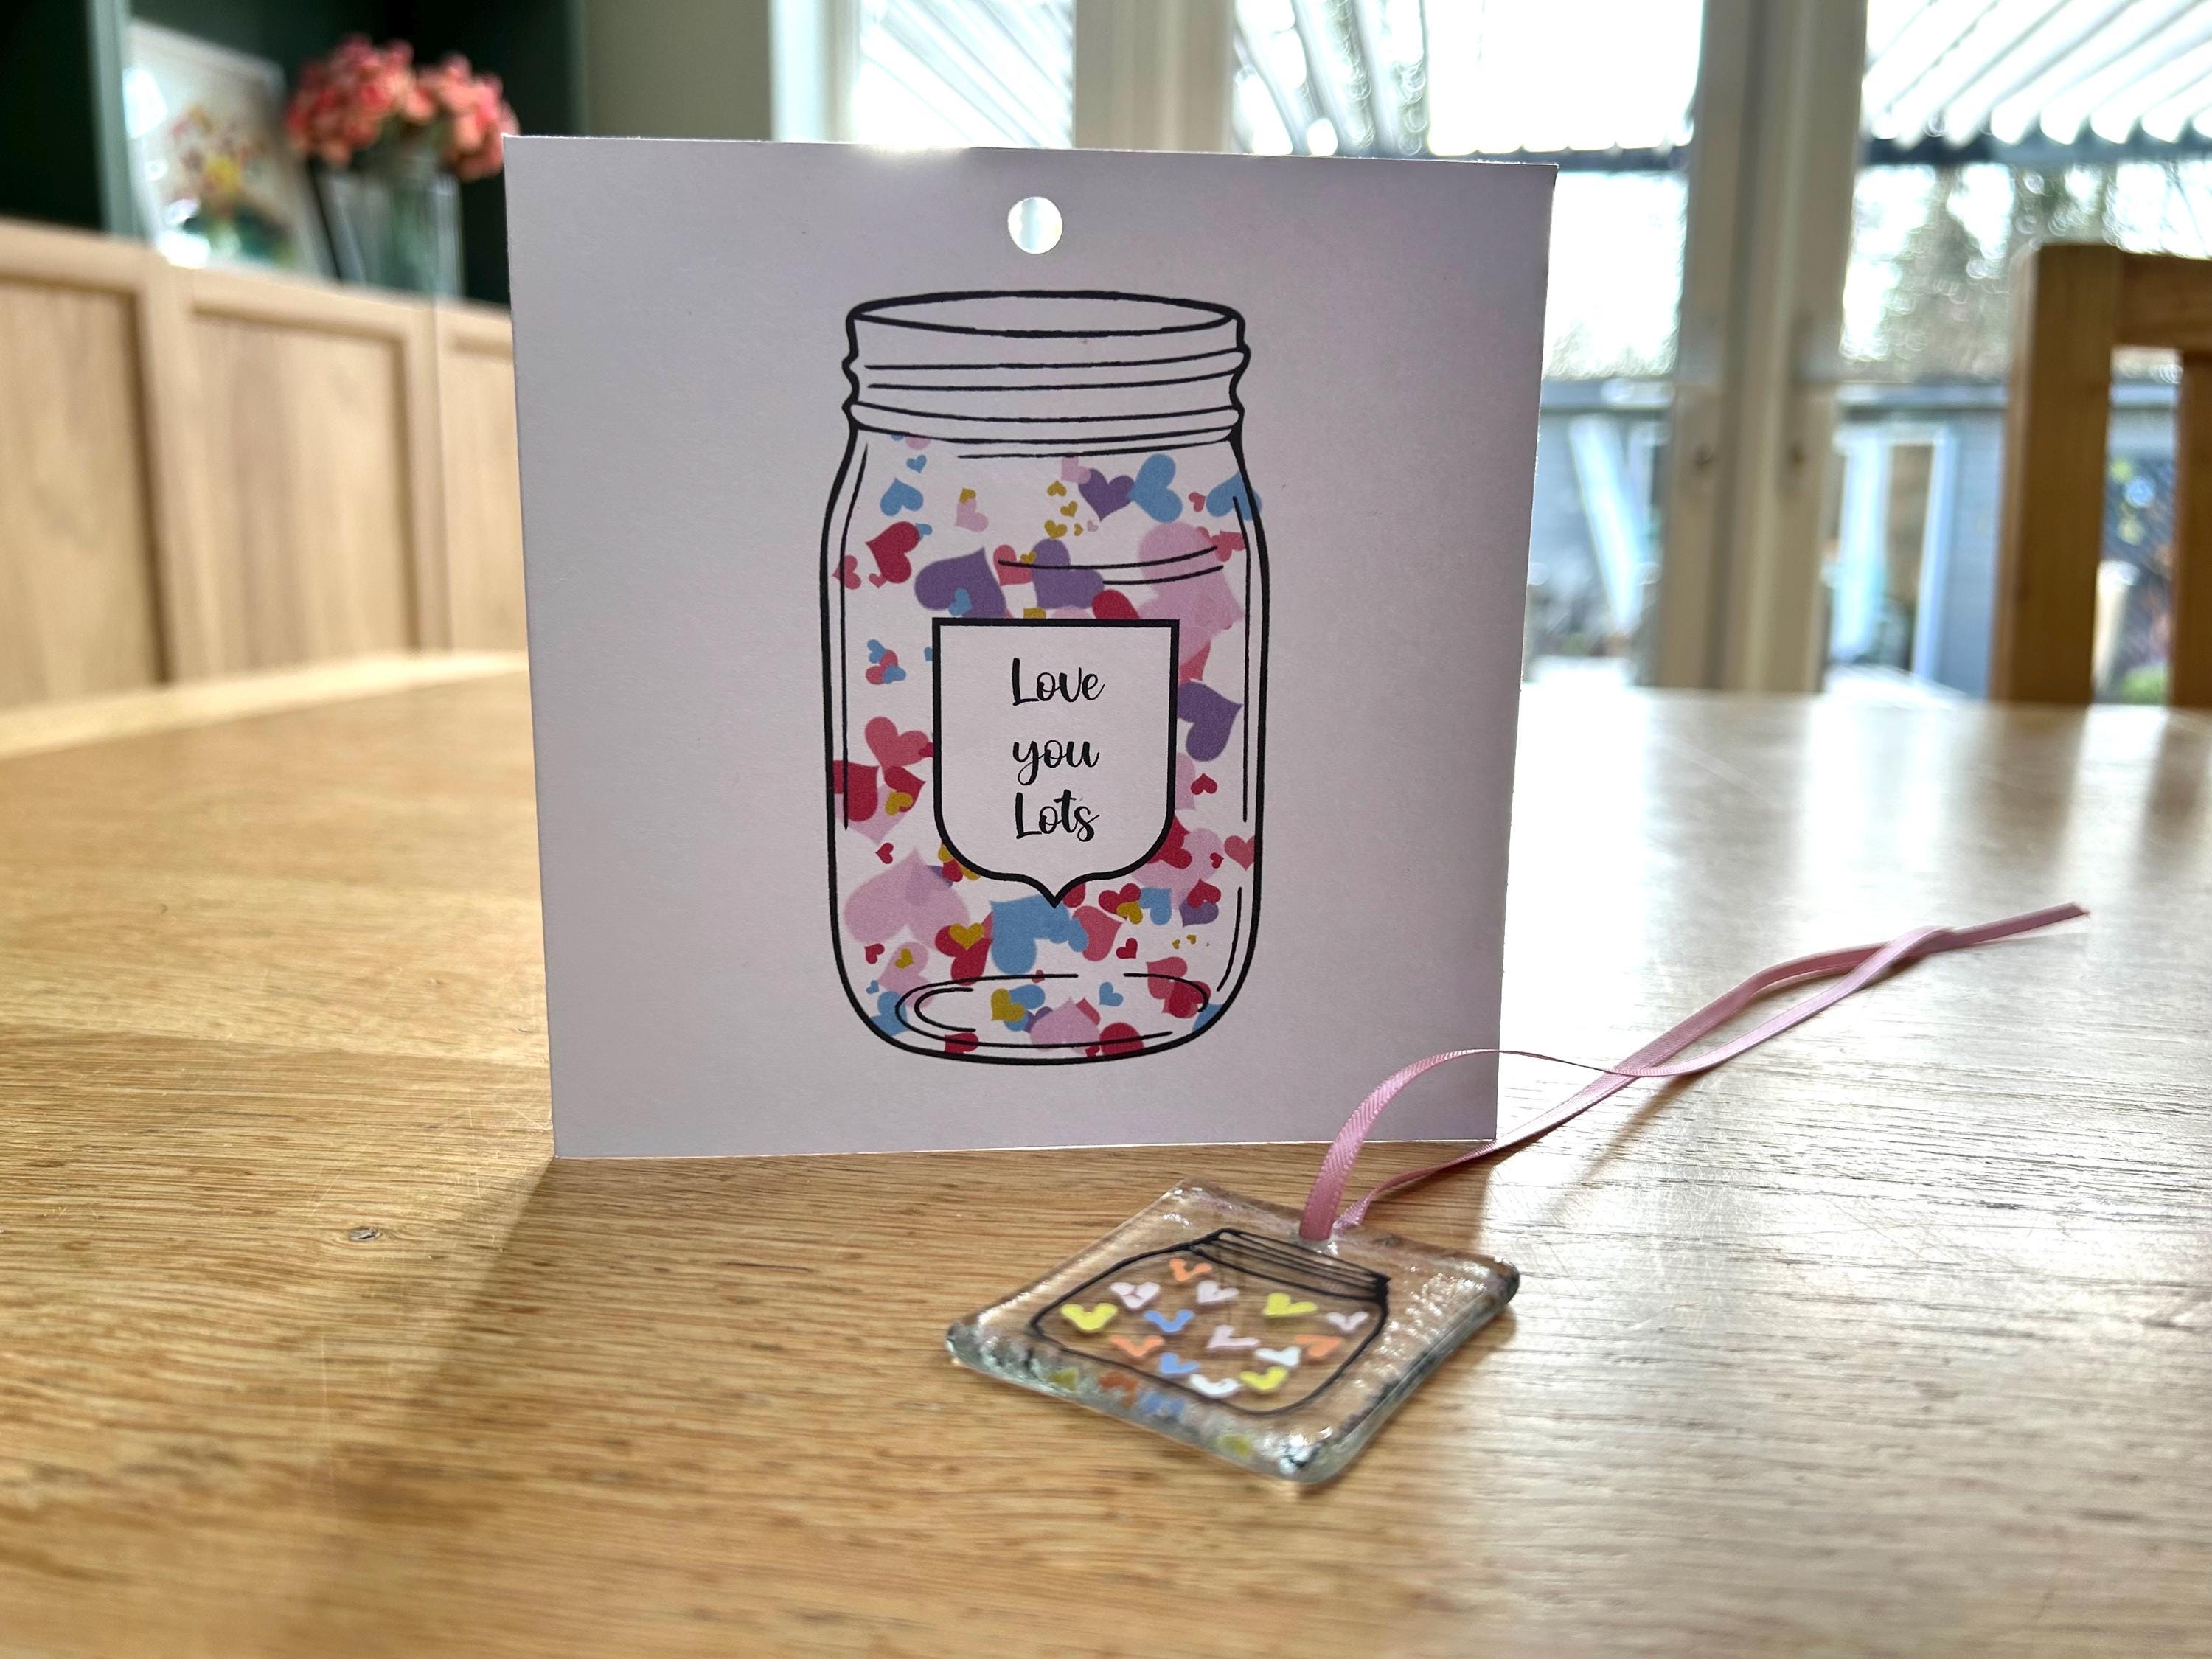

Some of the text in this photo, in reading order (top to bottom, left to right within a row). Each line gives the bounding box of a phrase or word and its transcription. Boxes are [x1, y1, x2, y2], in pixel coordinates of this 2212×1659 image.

[1011, 657, 1106, 706] Love
[1012, 739, 1100, 786] you
[1015, 789, 1100, 842] Lots
